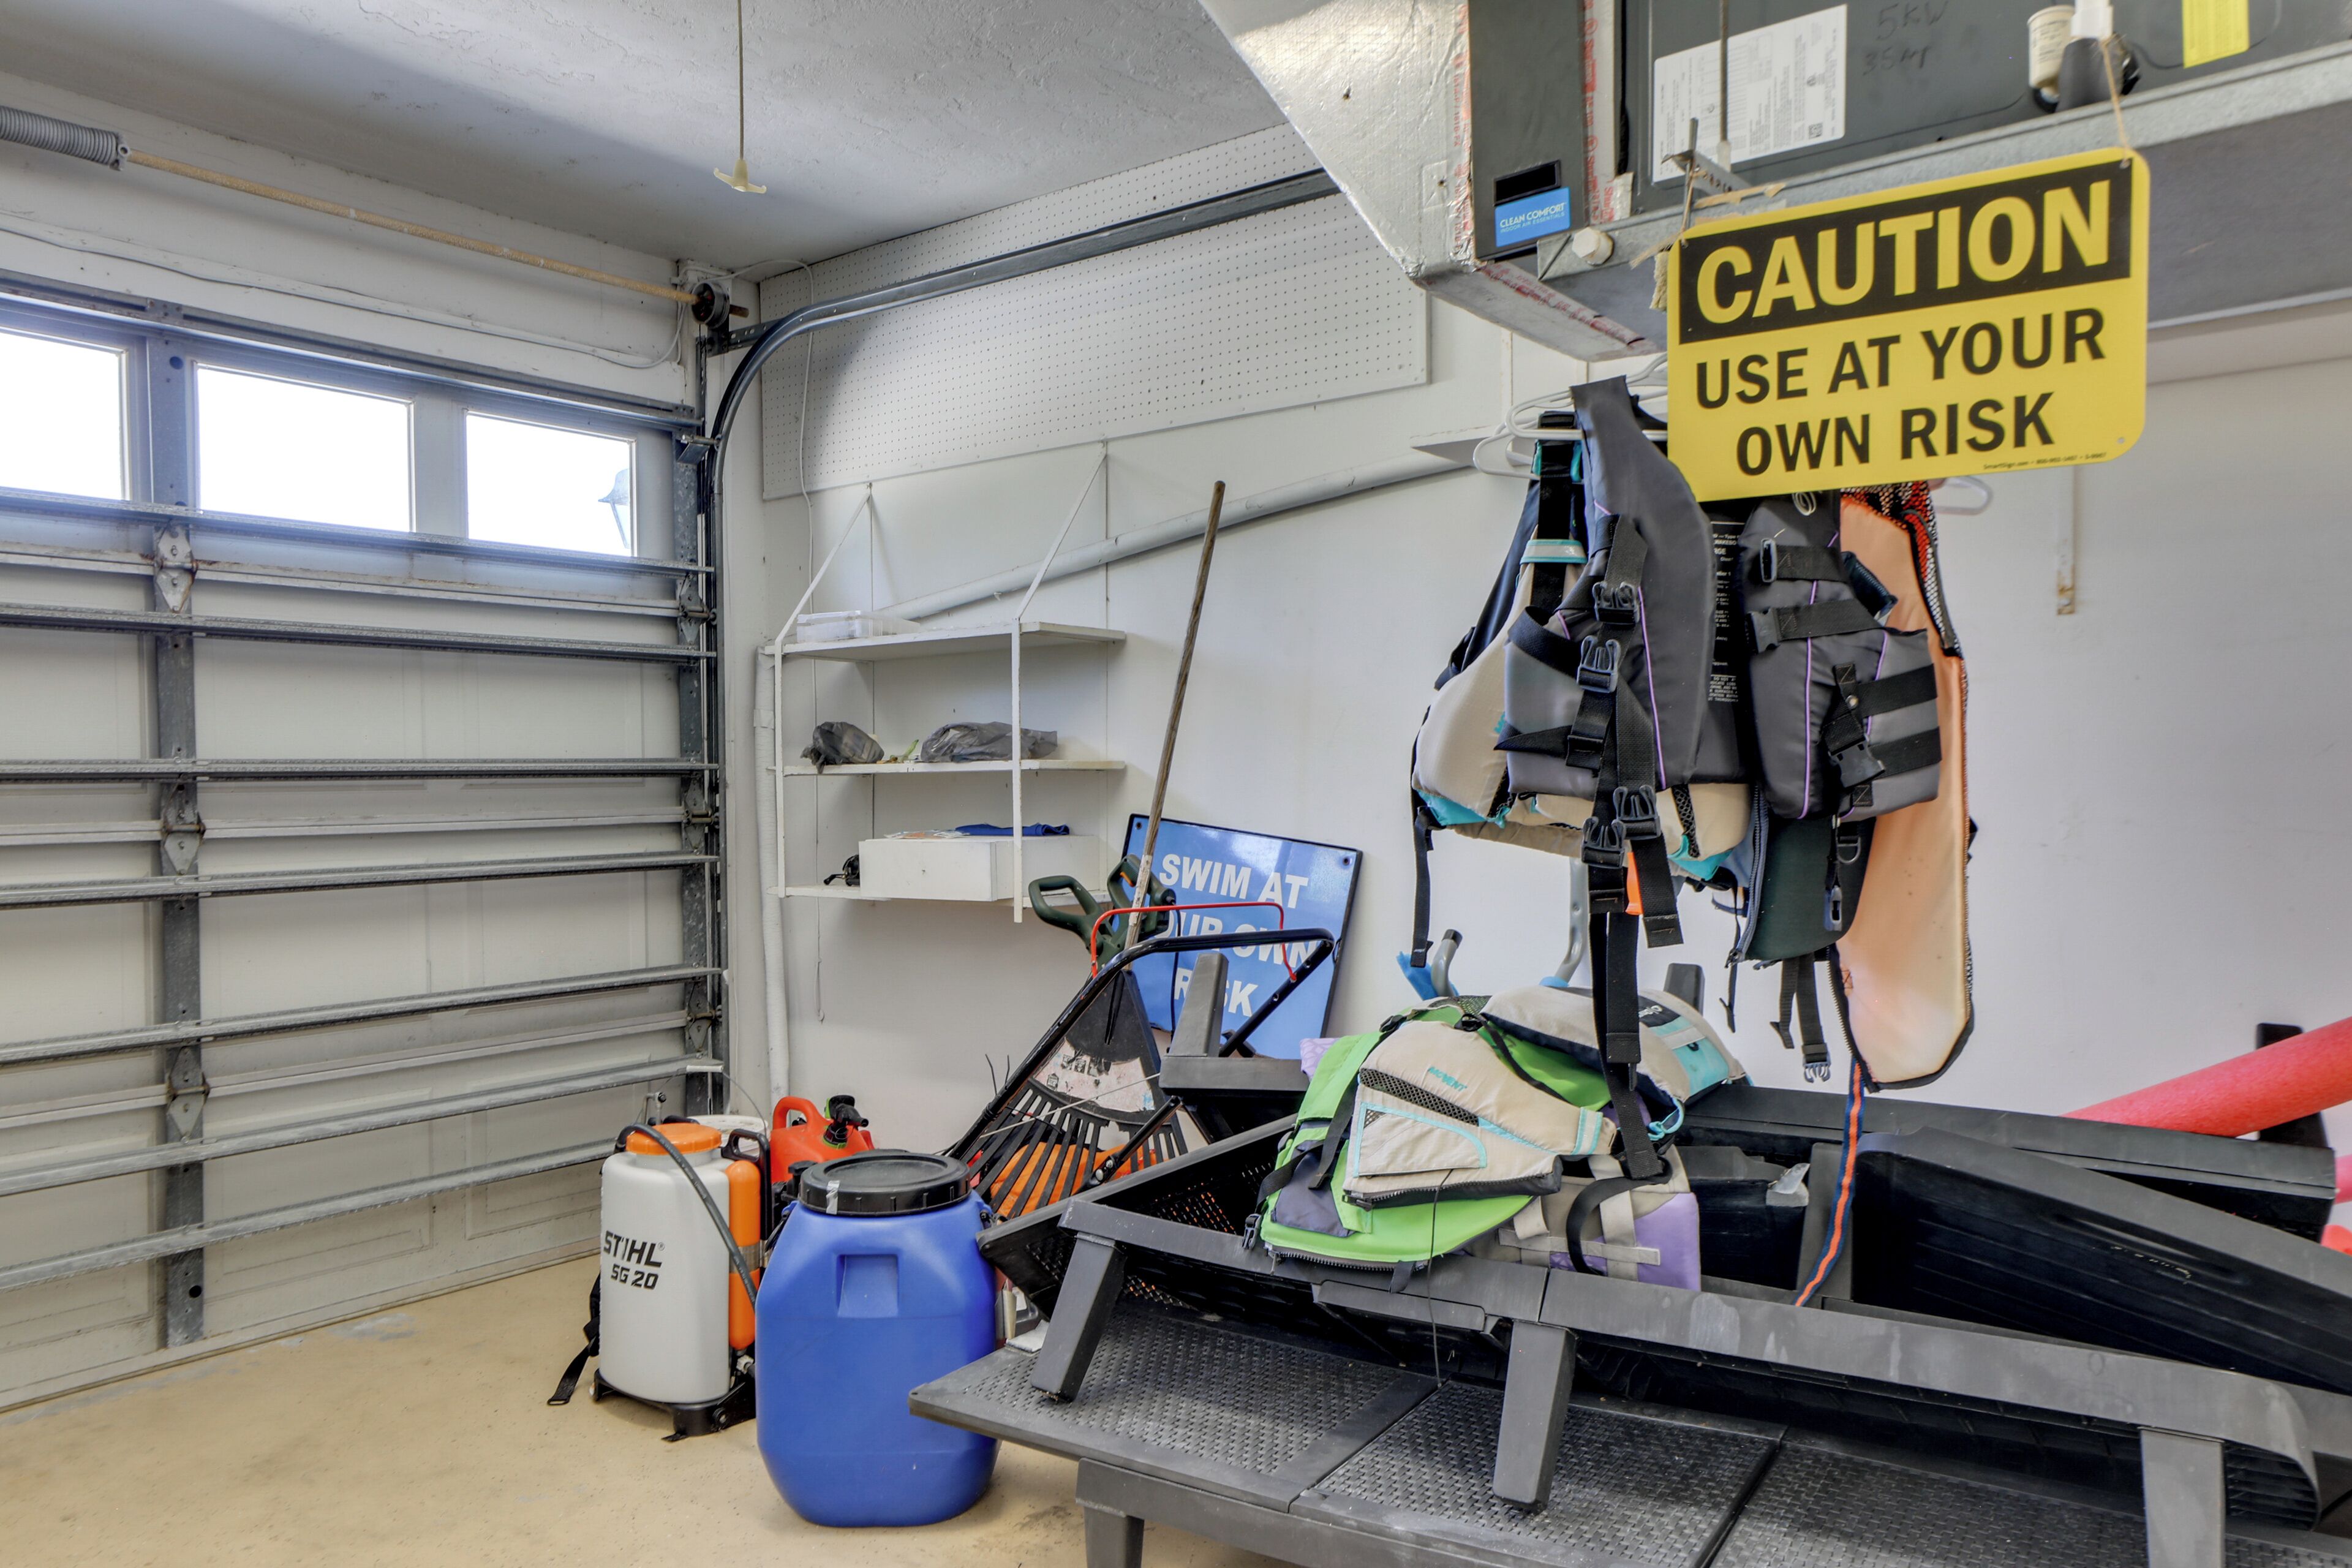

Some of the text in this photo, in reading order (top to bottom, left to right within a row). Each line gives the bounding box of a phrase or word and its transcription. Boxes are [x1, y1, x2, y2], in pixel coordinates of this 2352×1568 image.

[1499, 202, 1566, 228] CLEAN COMFORT
[1499, 224, 1521, 233] INDOOR
[1532, 211, 1566, 225] ESSENTIALS
[1697, 179, 2111, 325] CAUTION
[1696, 307, 2106, 410] USE AT YOUR
[1736, 391, 2055, 477] OWN RISK
[1159, 854, 1309, 909] SWIM AT
[1174, 968, 1259, 1017] RK
[603, 1230, 663, 1268] STIHL
[611, 1263, 660, 1291] SG 20
